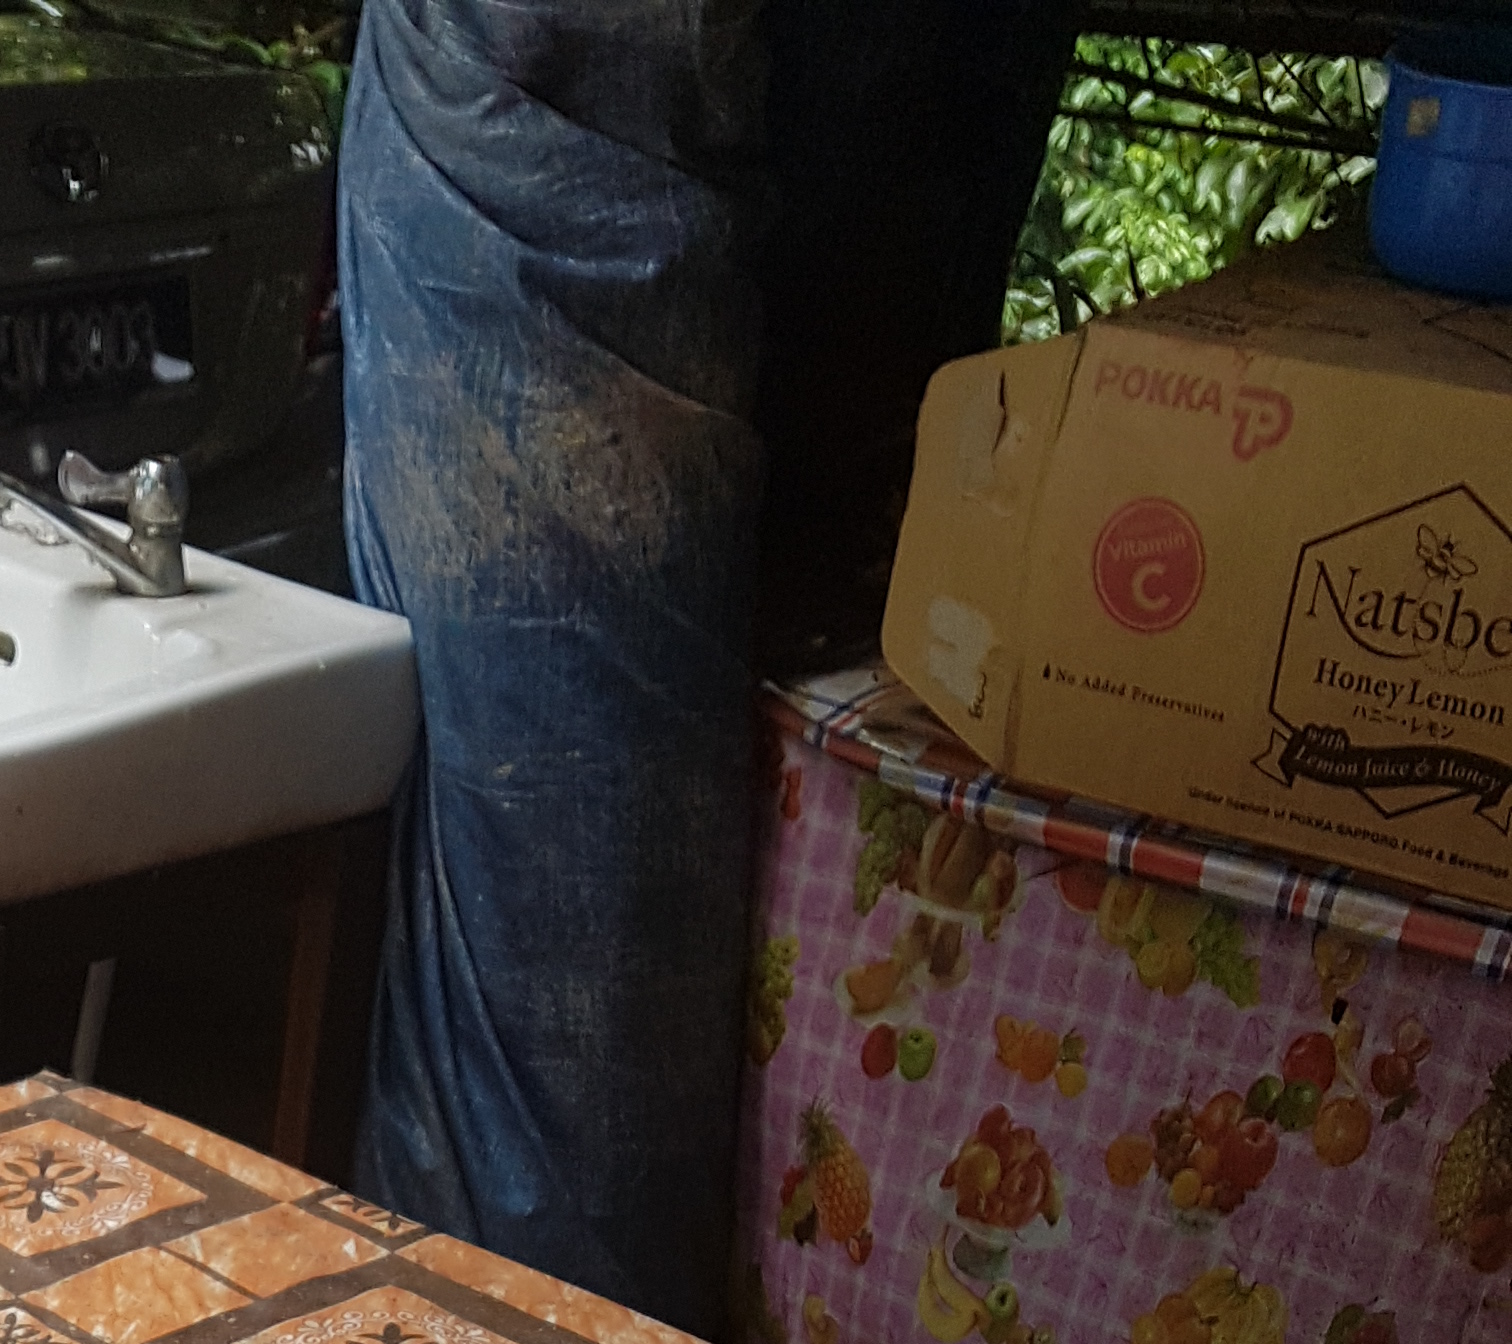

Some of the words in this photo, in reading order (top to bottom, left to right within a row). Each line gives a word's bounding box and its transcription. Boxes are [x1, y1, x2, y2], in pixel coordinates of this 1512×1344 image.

[1094, 359, 1222, 416] POKKA
[1107, 528, 1188, 562] Vitamin
[1131, 561, 1172, 611] C
[1055, 665, 1076, 685] No
[1082, 674, 1127, 697] Added
[1131, 684, 1226, 723] Preservatives
[1313, 657, 1404, 709] Honey
[1407, 677, 1506, 726] Lemon
[1305, 726, 1348, 751] with
[1293, 743, 1359, 777] Lemon
[1363, 756, 1409, 778] Juice
[1414, 756, 1432, 778] &
[1438, 757, 1503, 793] Honey
[1401, 840, 1433, 859] Food
